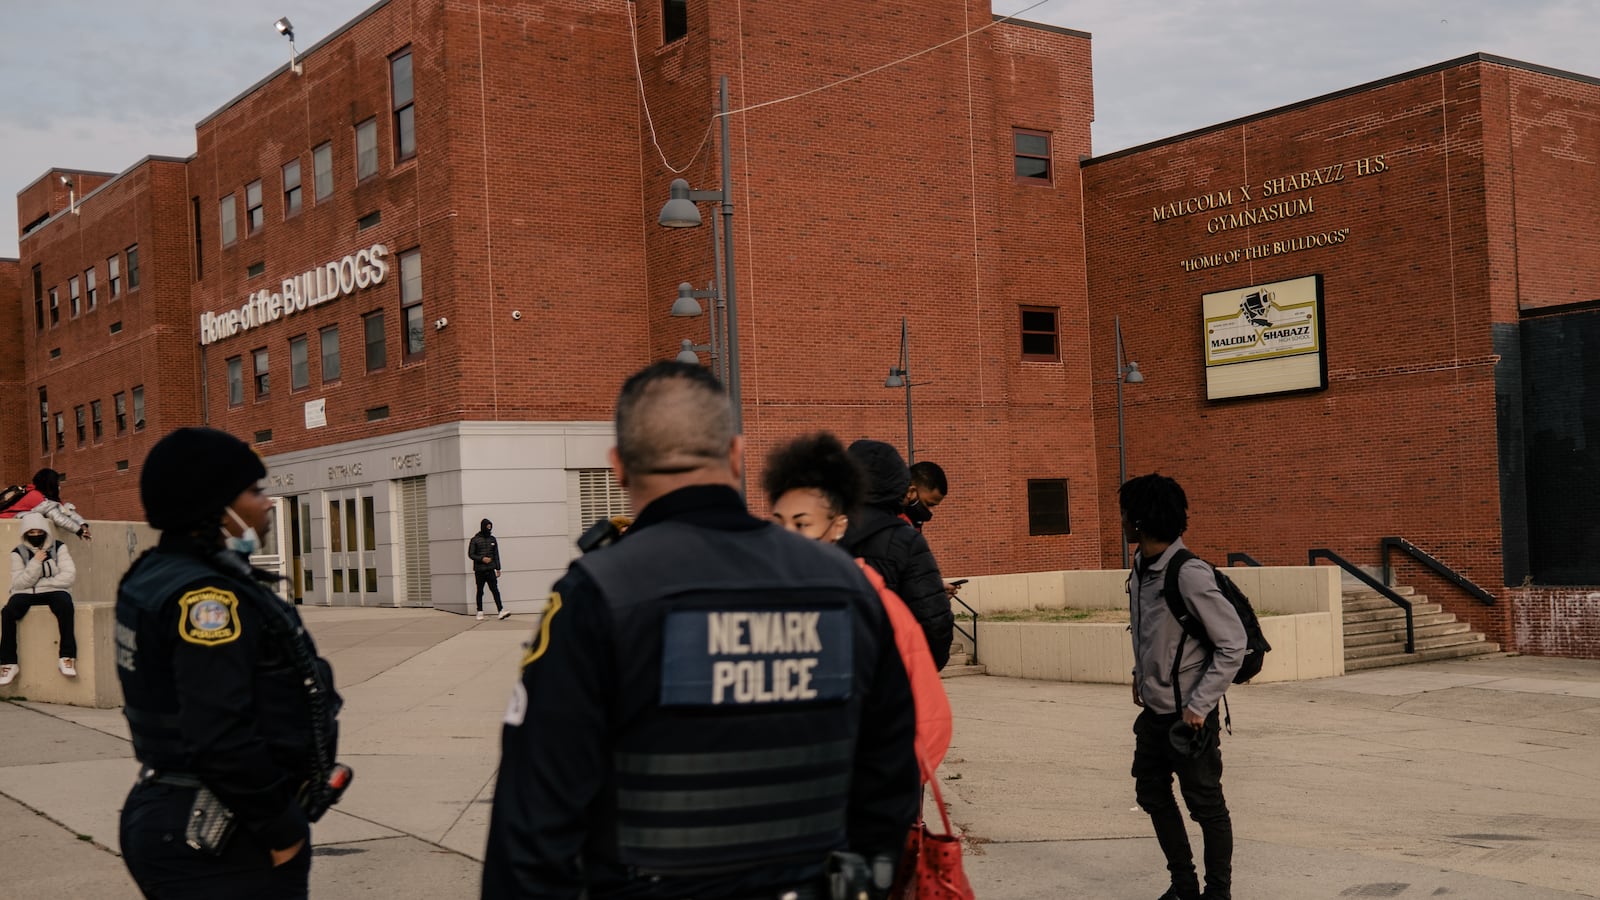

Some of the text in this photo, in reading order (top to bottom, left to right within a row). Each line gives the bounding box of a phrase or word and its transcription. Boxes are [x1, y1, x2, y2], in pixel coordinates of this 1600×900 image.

[1152, 154, 1390, 222] MALCOLM X SHABAZZ H.S.
[1207, 196, 1315, 234] GYMNASIUM
[1180, 227, 1350, 272] "HOME OF THE BULLDOGS"
[200, 243, 390, 345] Home of the BULLDOGS
[1211, 334, 1256, 348] MALCOLM
[1263, 326, 1310, 341] SHABAZZ
[327, 462, 363, 480] ENTRANCE
[391, 452, 423, 471] TICKETS
[707, 611, 823, 656] NEWARK
[711, 658, 819, 705] POLICE
